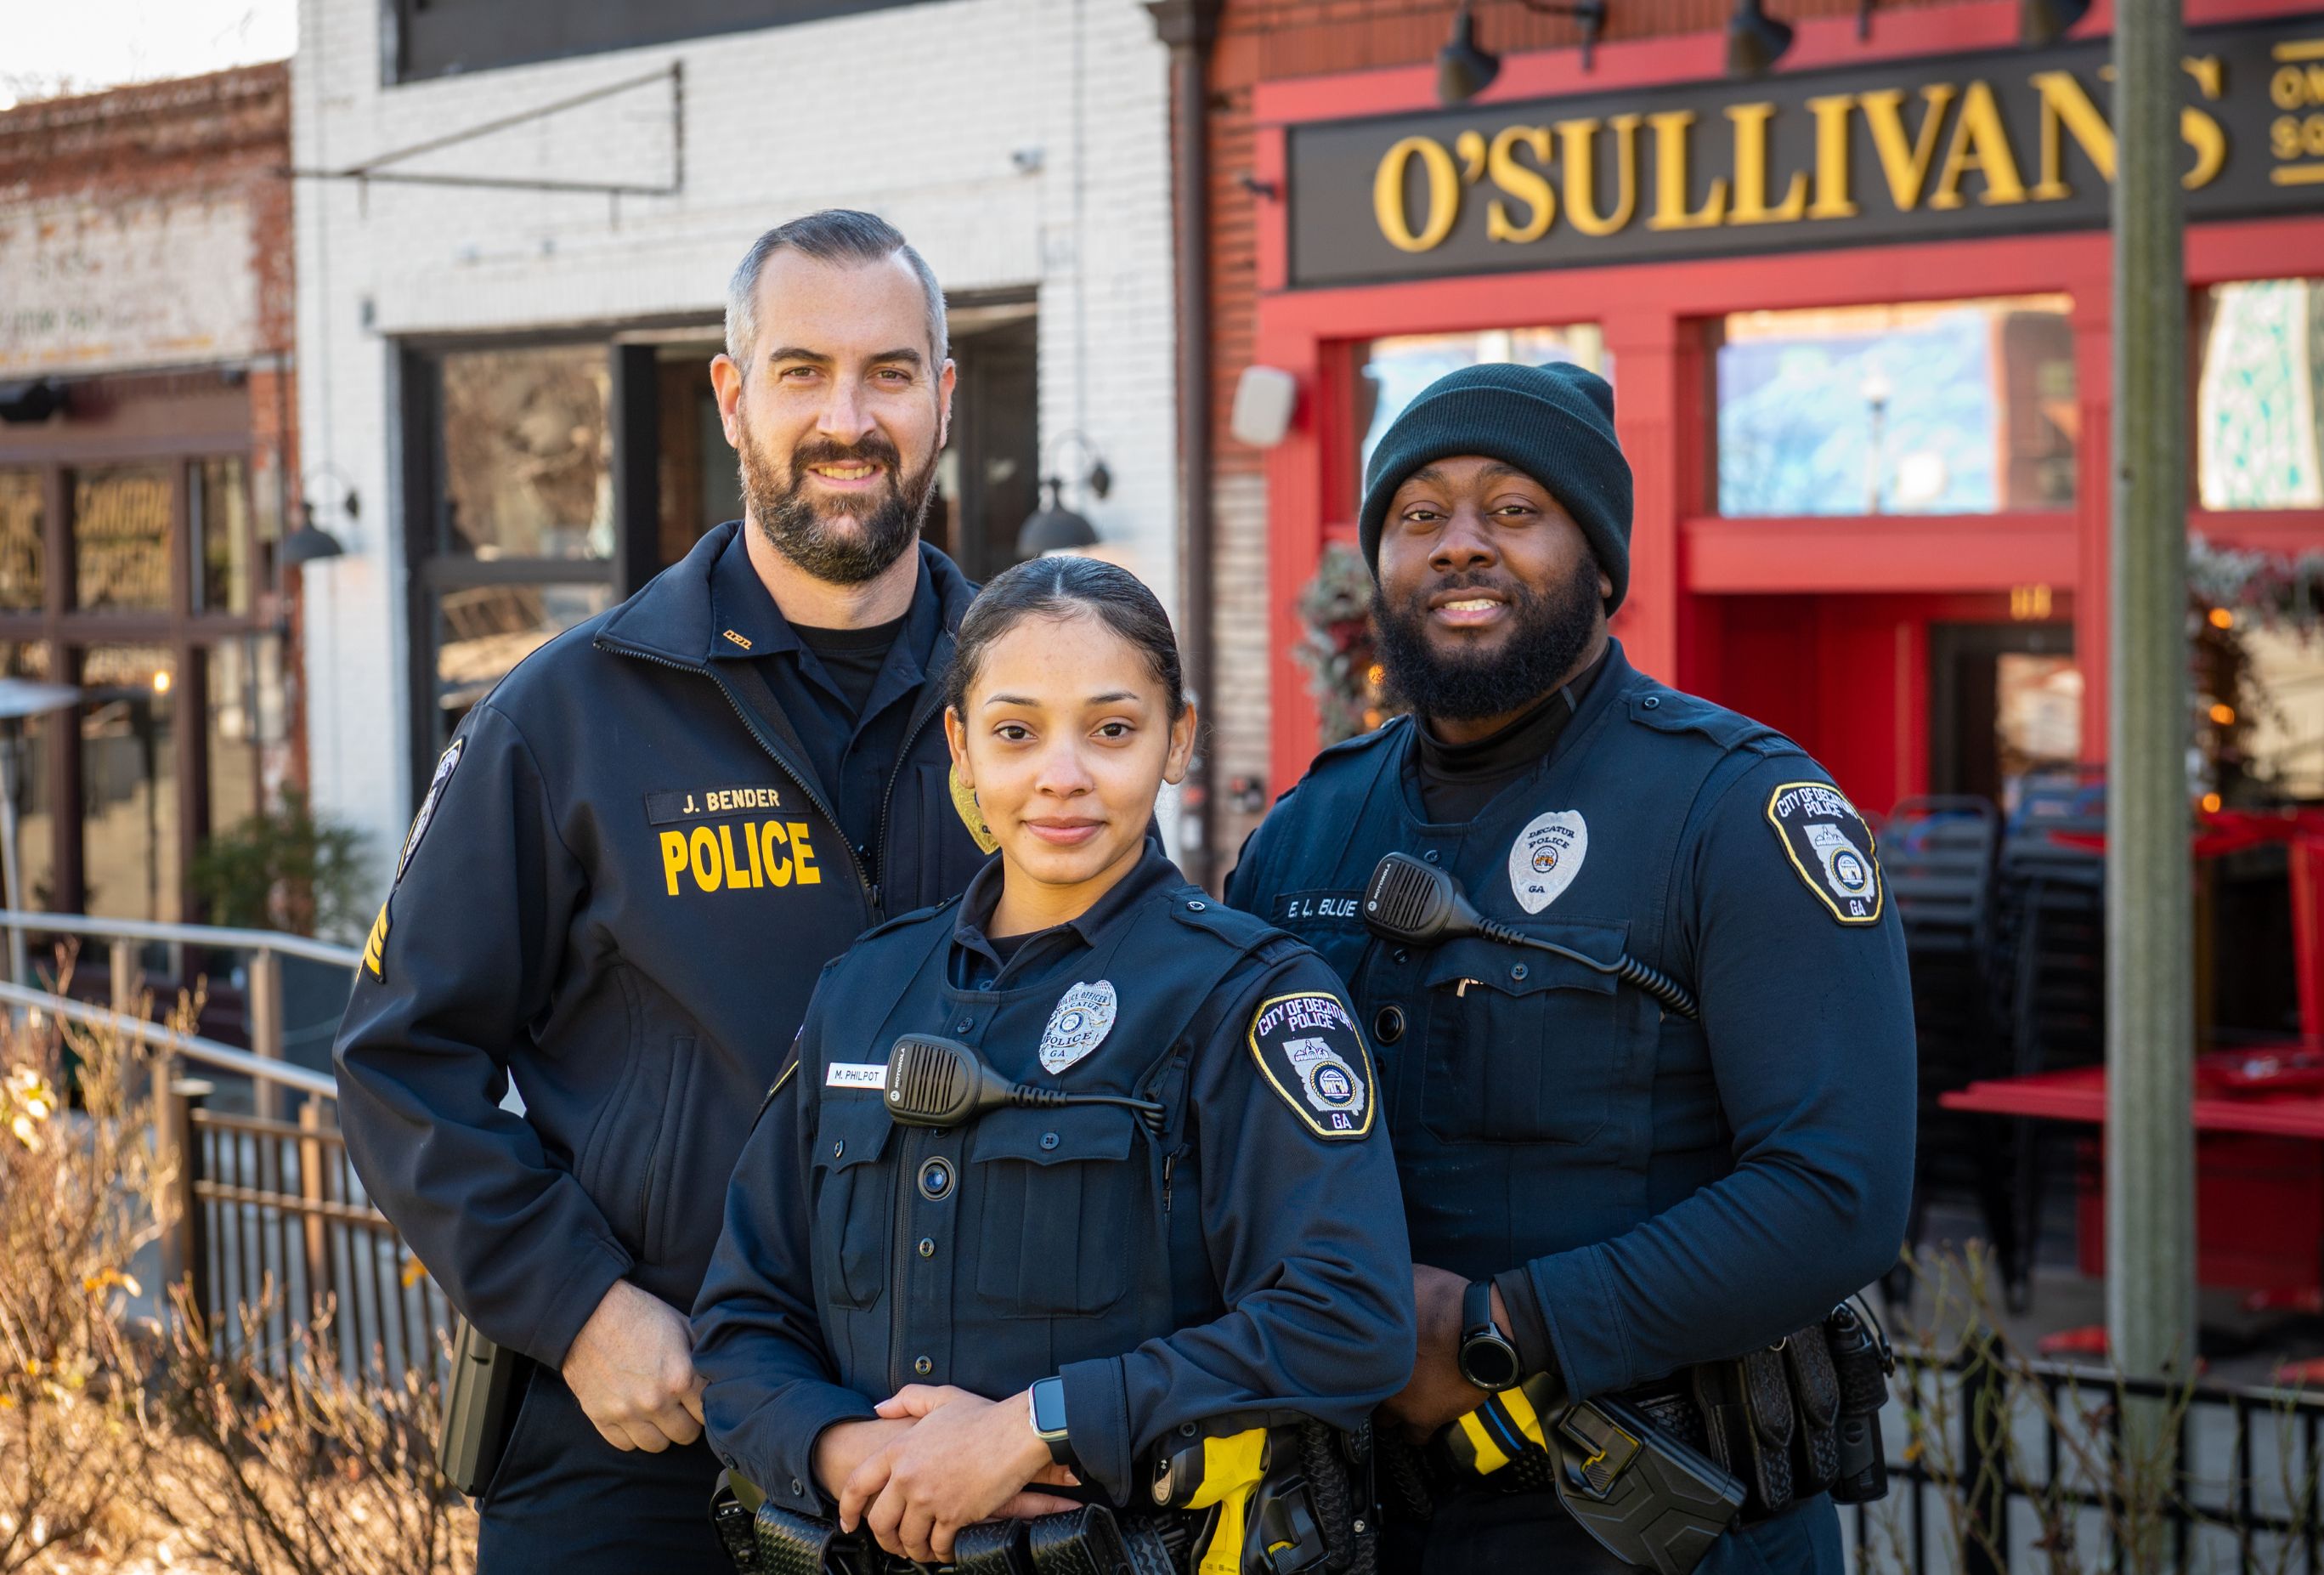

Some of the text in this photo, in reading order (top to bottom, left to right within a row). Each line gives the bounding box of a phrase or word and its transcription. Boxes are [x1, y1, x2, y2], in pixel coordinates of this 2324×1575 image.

[682, 789, 781, 814] J. BENDER
[1777, 790, 1800, 819] CITY
[1798, 787, 1814, 802] OF
[1803, 801, 1844, 819] POLICE
[1528, 825, 1575, 839] DECATUR
[1528, 836, 1570, 849] POLICE
[659, 820, 822, 897] POLICE
[1374, 863, 1392, 900] MOTOROLA
[1529, 885, 1546, 893] GA
[1317, 898, 1359, 917] BLUE
[1849, 899, 1867, 916] GA
[1057, 991, 1108, 1008] POLICE OFFICER
[1058, 1001, 1100, 1015] DECATUR
[1258, 997, 1354, 1037] CITY OF DECATUR
[1287, 1012, 1336, 1032] POLICE
[1046, 1032, 1093, 1045] POLICE
[834, 1069, 879, 1081] M. PHILPOT
[895, 1047, 906, 1088] MOTOROLA
[1332, 1113, 1353, 1130] GA
